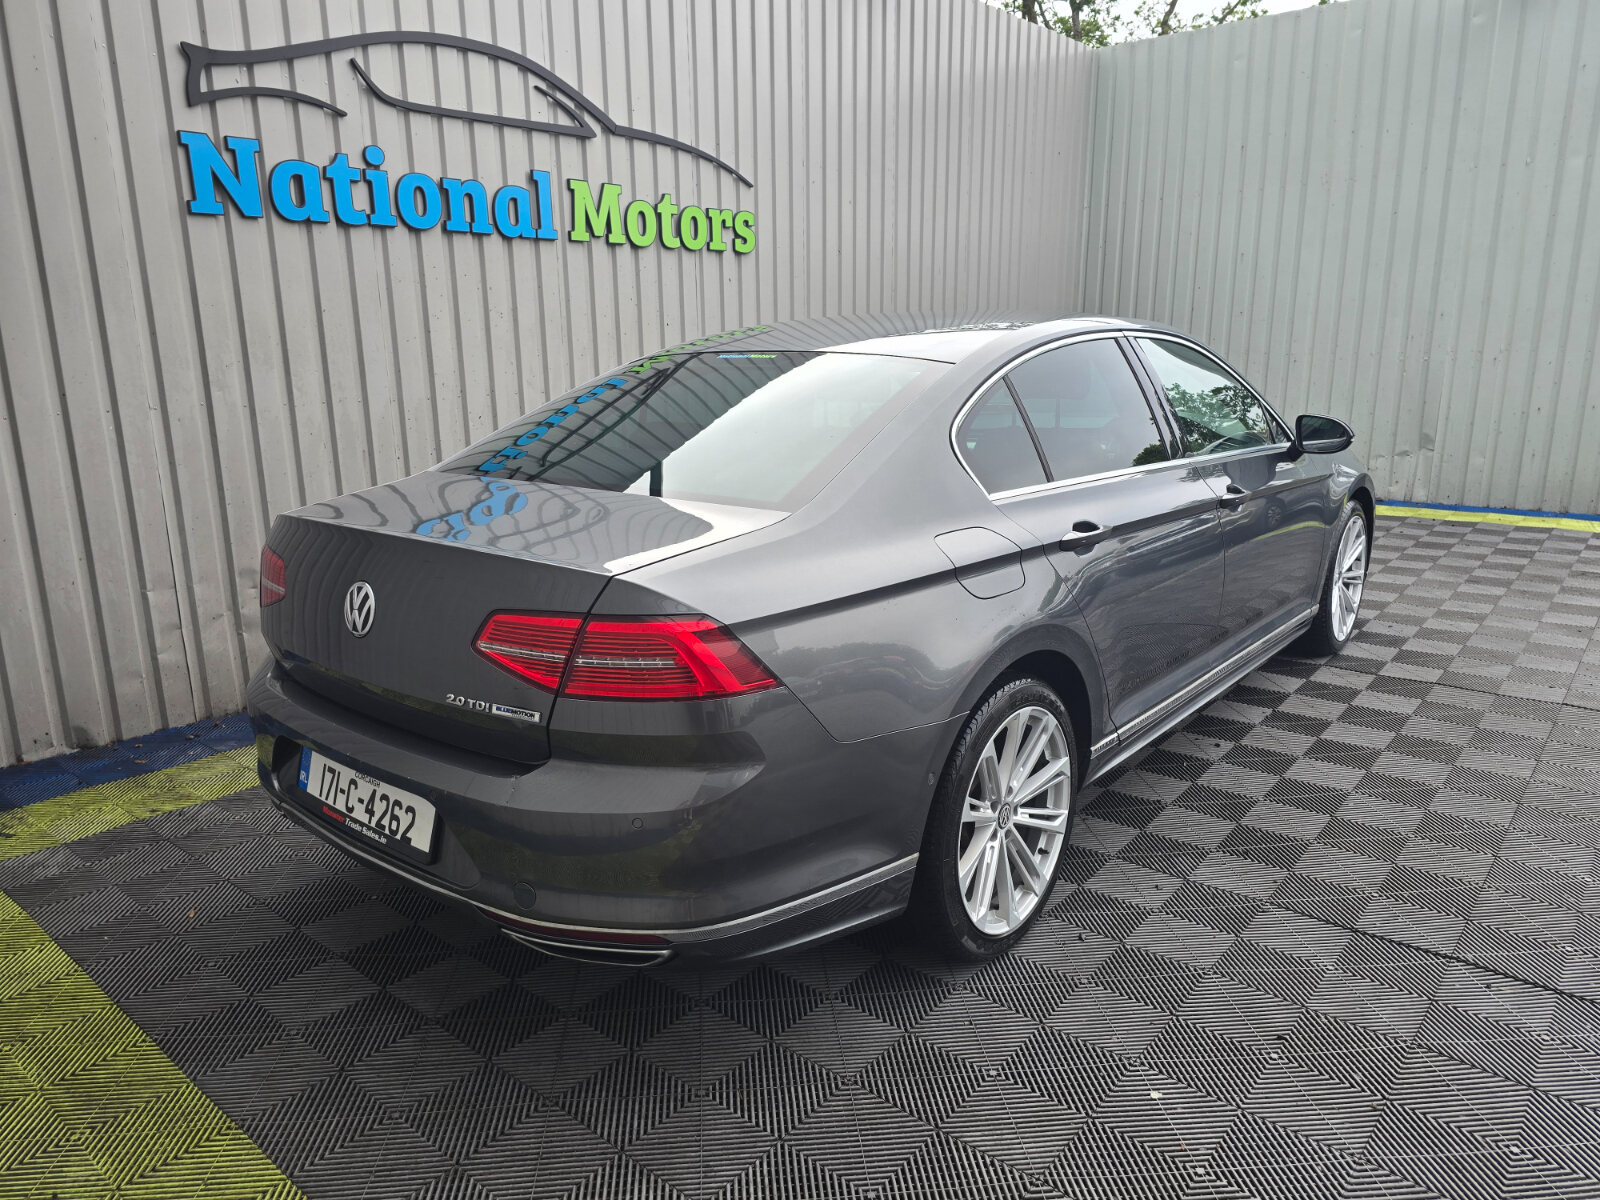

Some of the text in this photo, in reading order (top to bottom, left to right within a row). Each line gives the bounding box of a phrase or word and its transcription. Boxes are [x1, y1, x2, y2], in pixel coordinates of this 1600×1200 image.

[178, 130, 757, 255] National Motors
[467, 698, 490, 712] TDI
[319, 763, 416, 845] 171-C-4262
[345, 817, 362, 833] Trade
